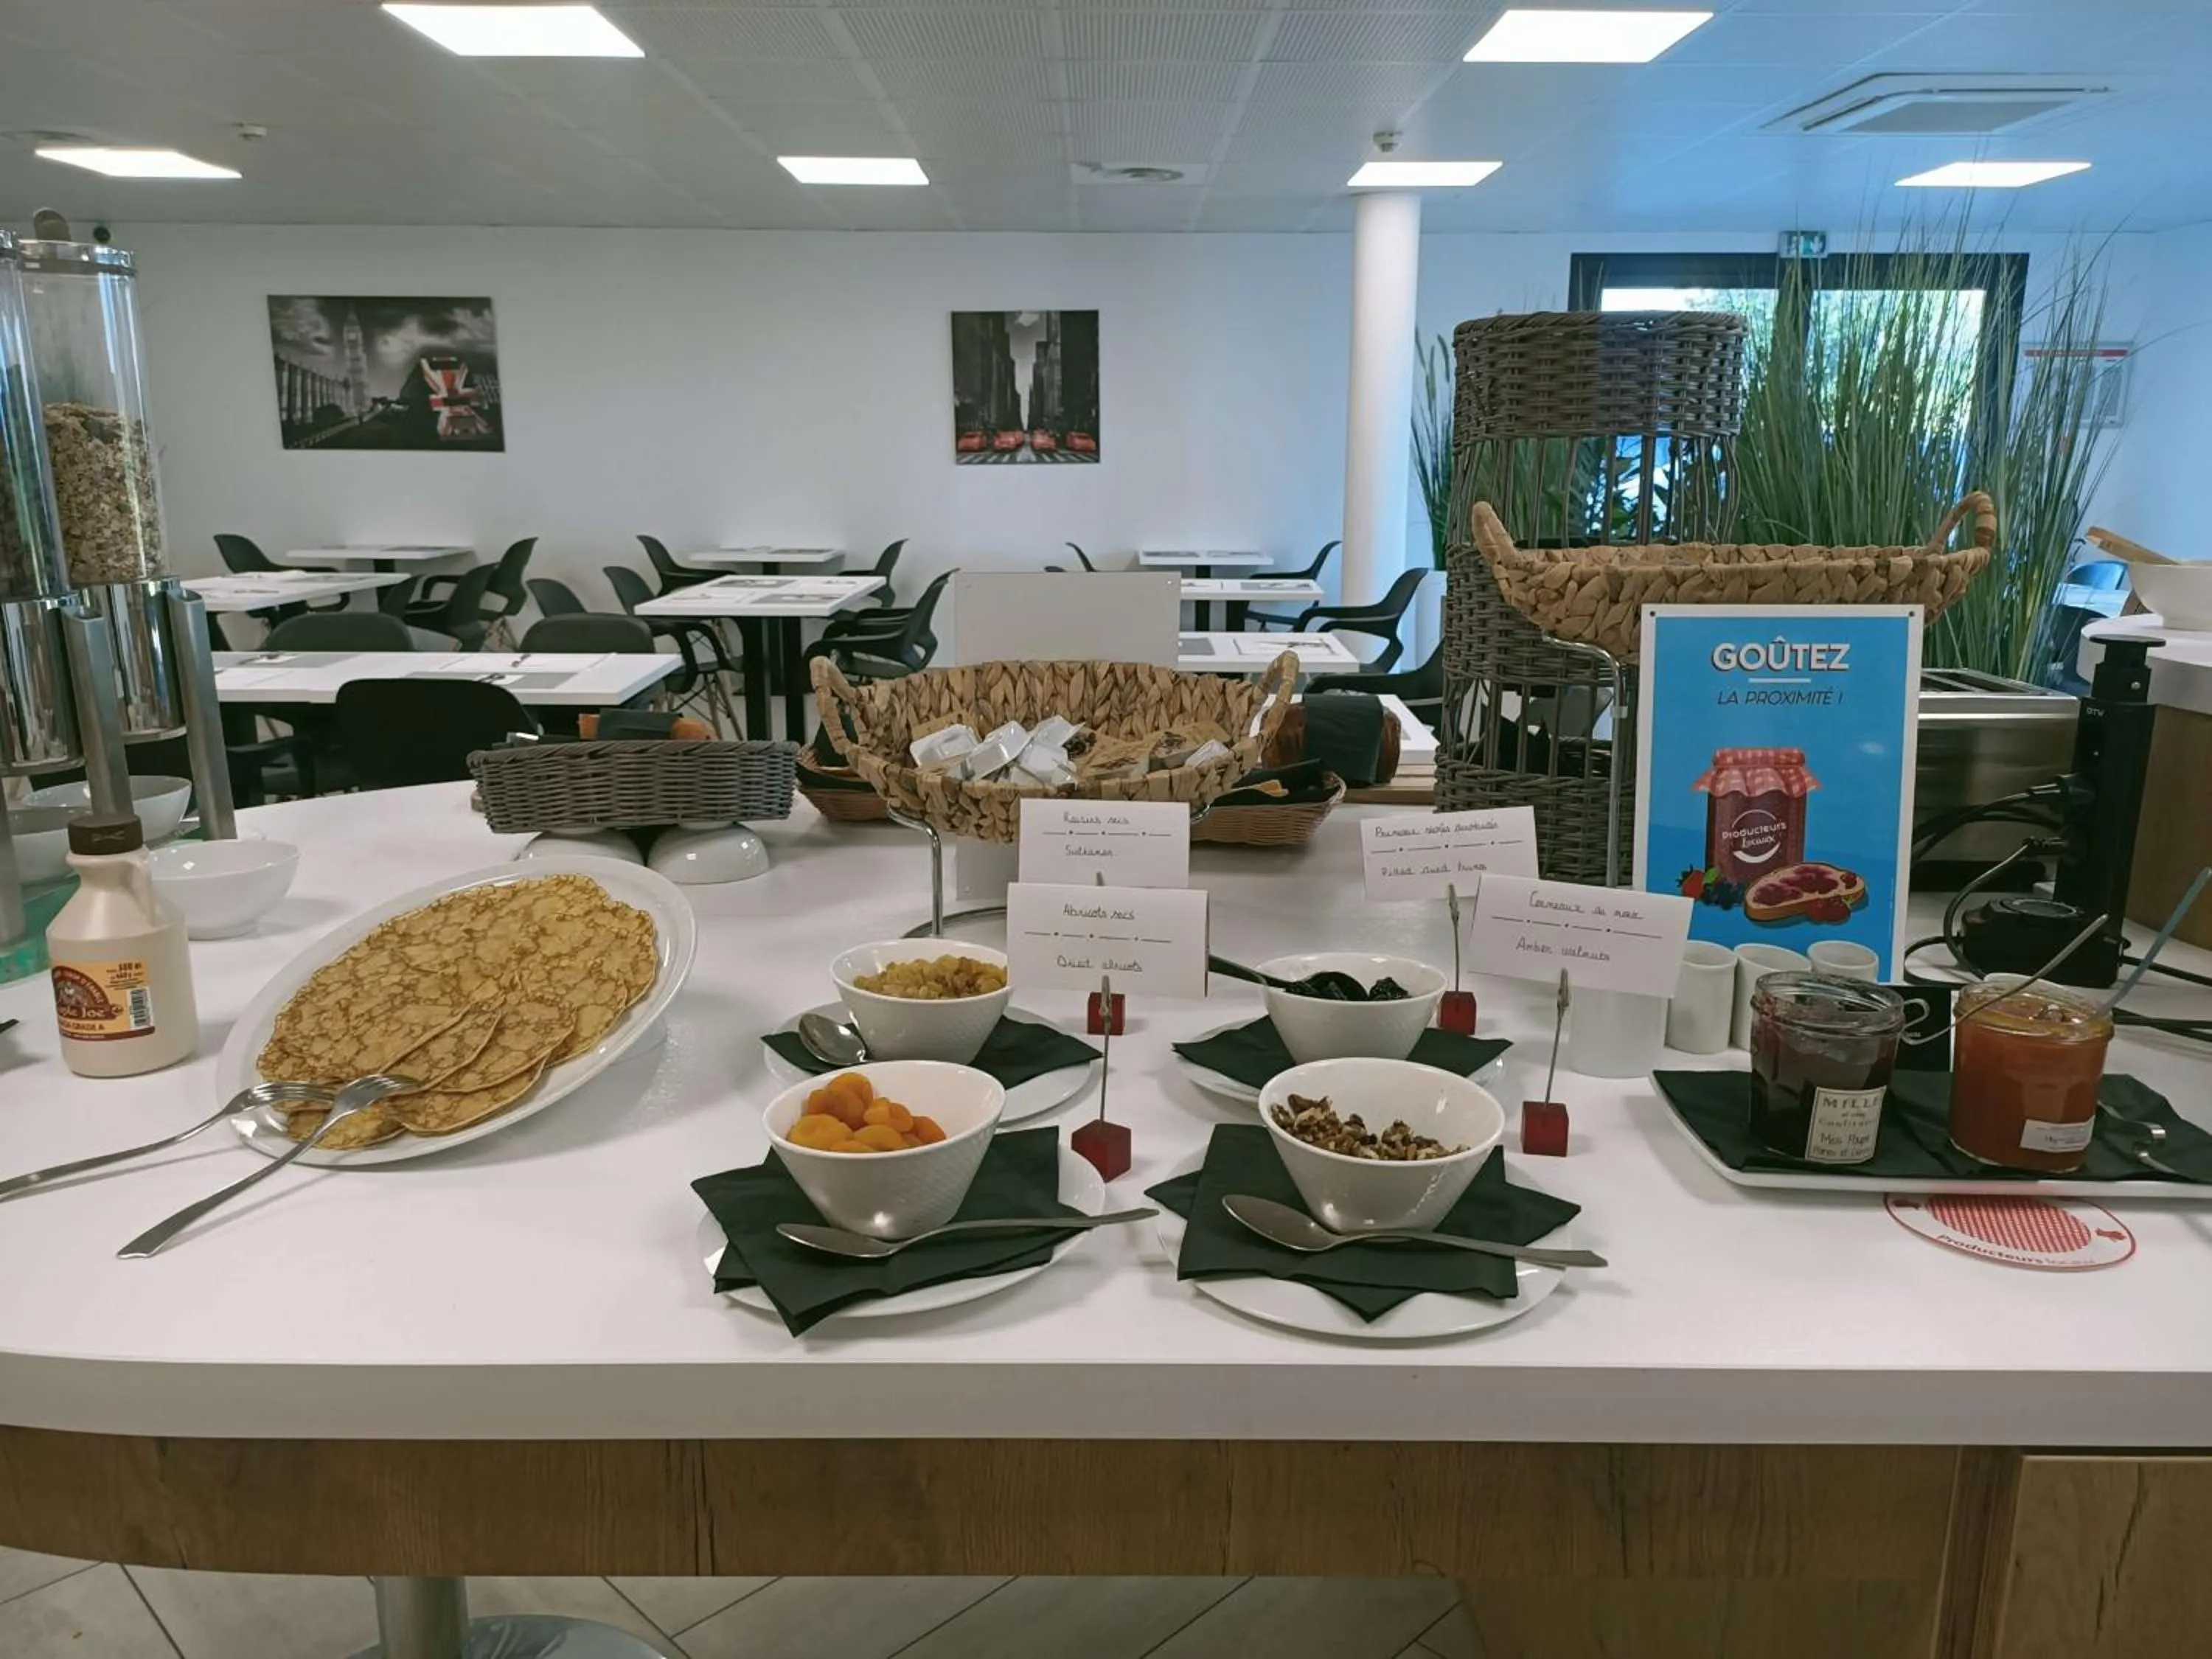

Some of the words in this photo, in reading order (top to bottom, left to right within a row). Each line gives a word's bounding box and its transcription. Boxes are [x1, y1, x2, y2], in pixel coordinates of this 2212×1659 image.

[1711, 635, 1851, 672] GOÛTEZ
[1717, 690, 1739, 706] LA
[1745, 686, 1834, 706] PROXIMITÉ
